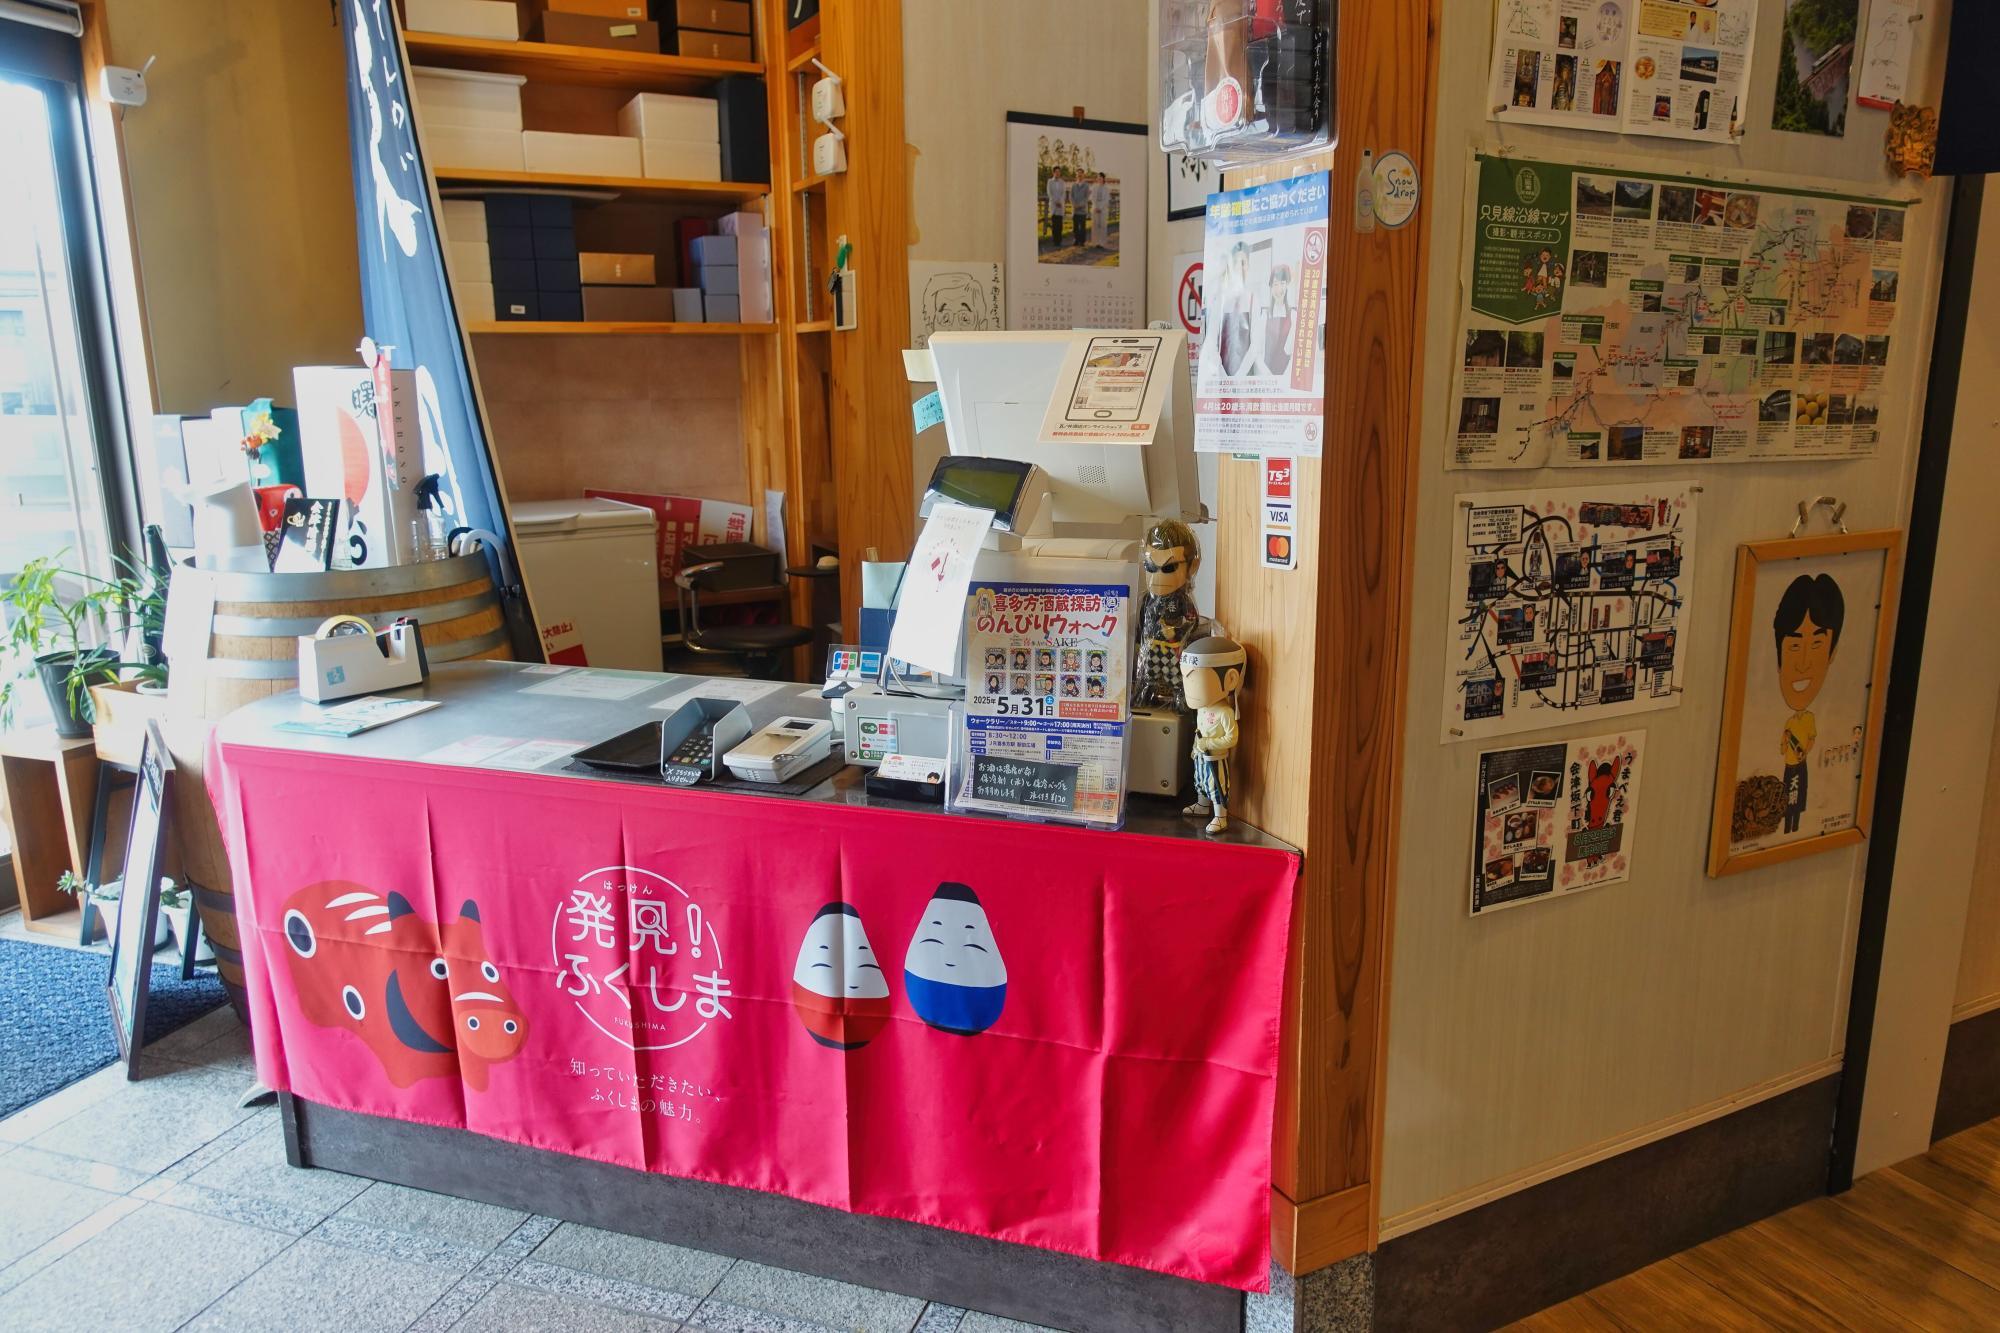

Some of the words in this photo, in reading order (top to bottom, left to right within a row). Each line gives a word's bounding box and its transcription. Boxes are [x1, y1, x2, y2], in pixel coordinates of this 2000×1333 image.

[1387, 169, 1412, 195] Snow
[1394, 186, 1416, 200] drop
[1480, 205, 1568, 226] 只見線沿線マップ
[1492, 228, 1553, 241] 撮影・観光スポット
[1044, 278, 1050, 287] 5
[1107, 280, 1113, 289] 6
[1270, 511, 1289, 523] VISA
[993, 594, 1101, 612] 喜多方酒蔵探訪
[1570, 762, 1581, 830] 会津坂下町
[1613, 752, 1633, 823] うまべえ君
[603, 880, 653, 895] はっけん
[566, 889, 703, 959] 発見!
[556, 953, 733, 1020] ふくしま
[614, 1017, 667, 1031] FUKUSHIMA
[570, 1058, 721, 1102] 知っていただきたい、
[591, 1088, 702, 1124] ふくしまの魅力。
